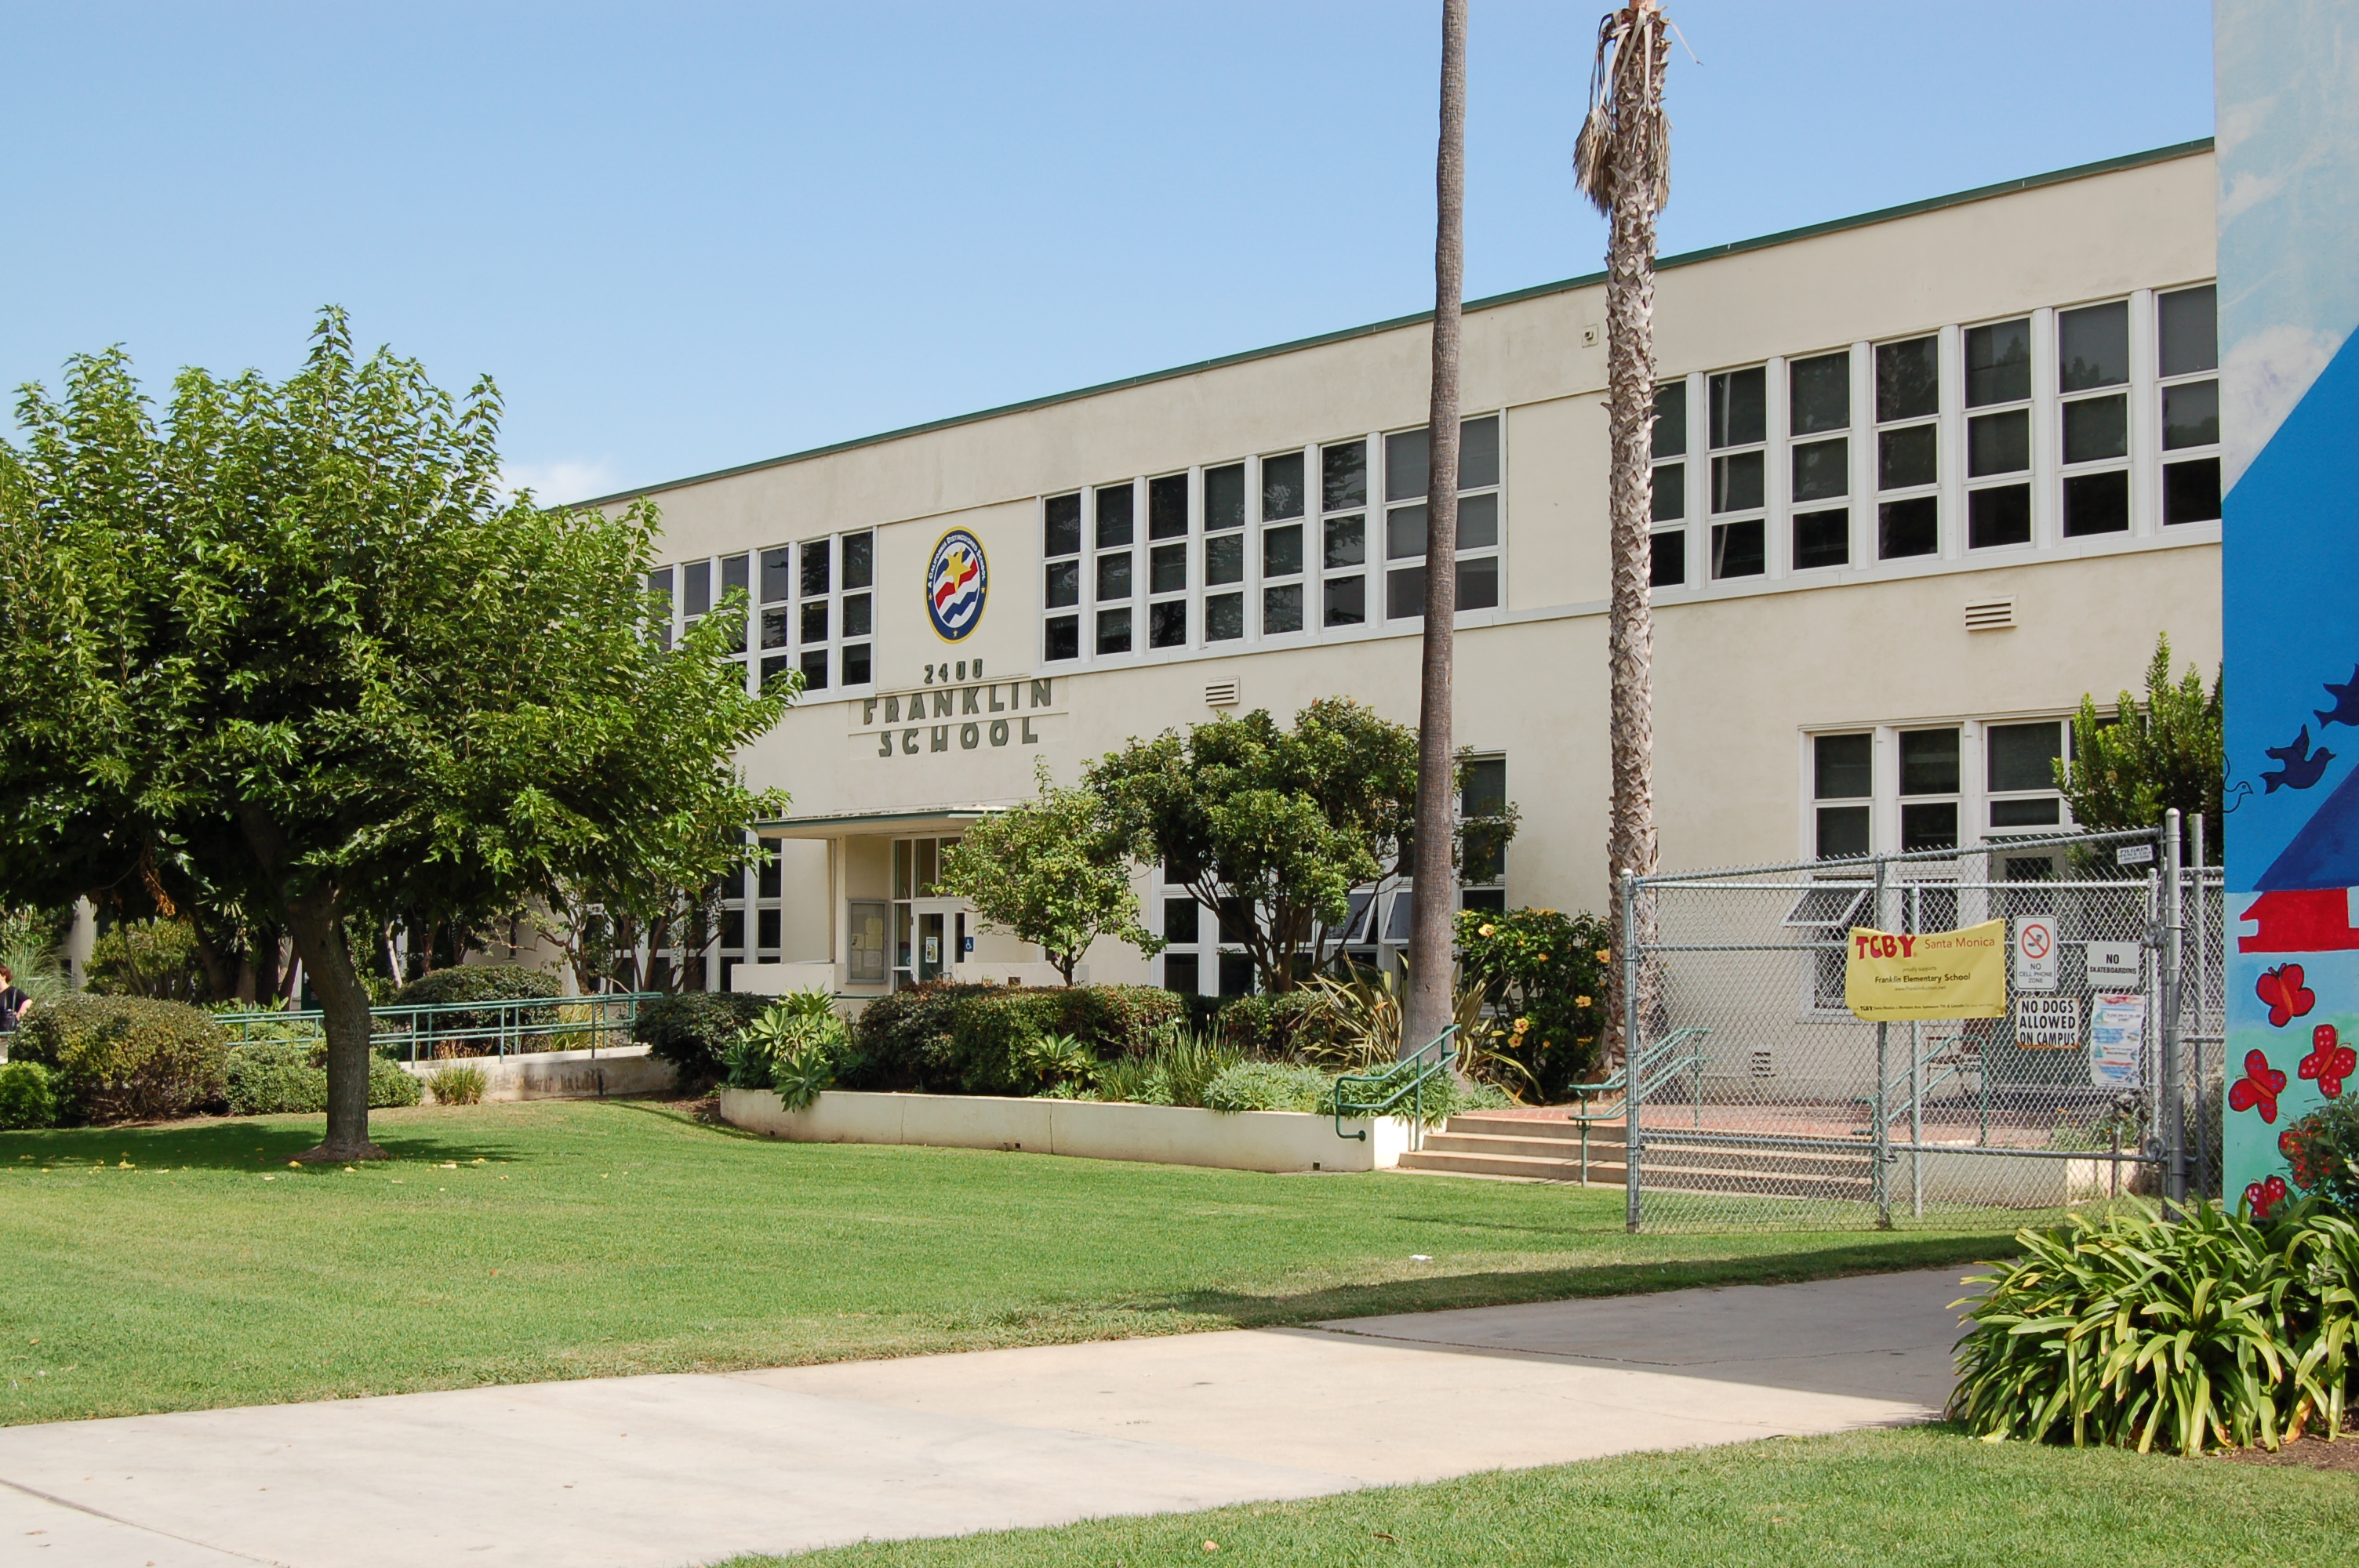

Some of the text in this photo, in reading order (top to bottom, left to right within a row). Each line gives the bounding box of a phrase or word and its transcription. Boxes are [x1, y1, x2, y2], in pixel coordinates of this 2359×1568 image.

[924, 659, 983, 684] 2400
[863, 678, 1051, 725] FRANKLIN
[878, 717, 1038, 757] SCHOOL
[1856, 935, 1995, 960] TCBY Santa Monica
[2106, 953, 2120, 964] NO
[2089, 966, 2137, 975] SKATEBOARDING
[1874, 972, 1971, 984] Franklin Elementary School
[2021, 1000, 2074, 1014] NO DOGS
[2019, 1015, 2076, 1029] ALLOWED
[2019, 1032, 2075, 1046] ON CAMPUS
